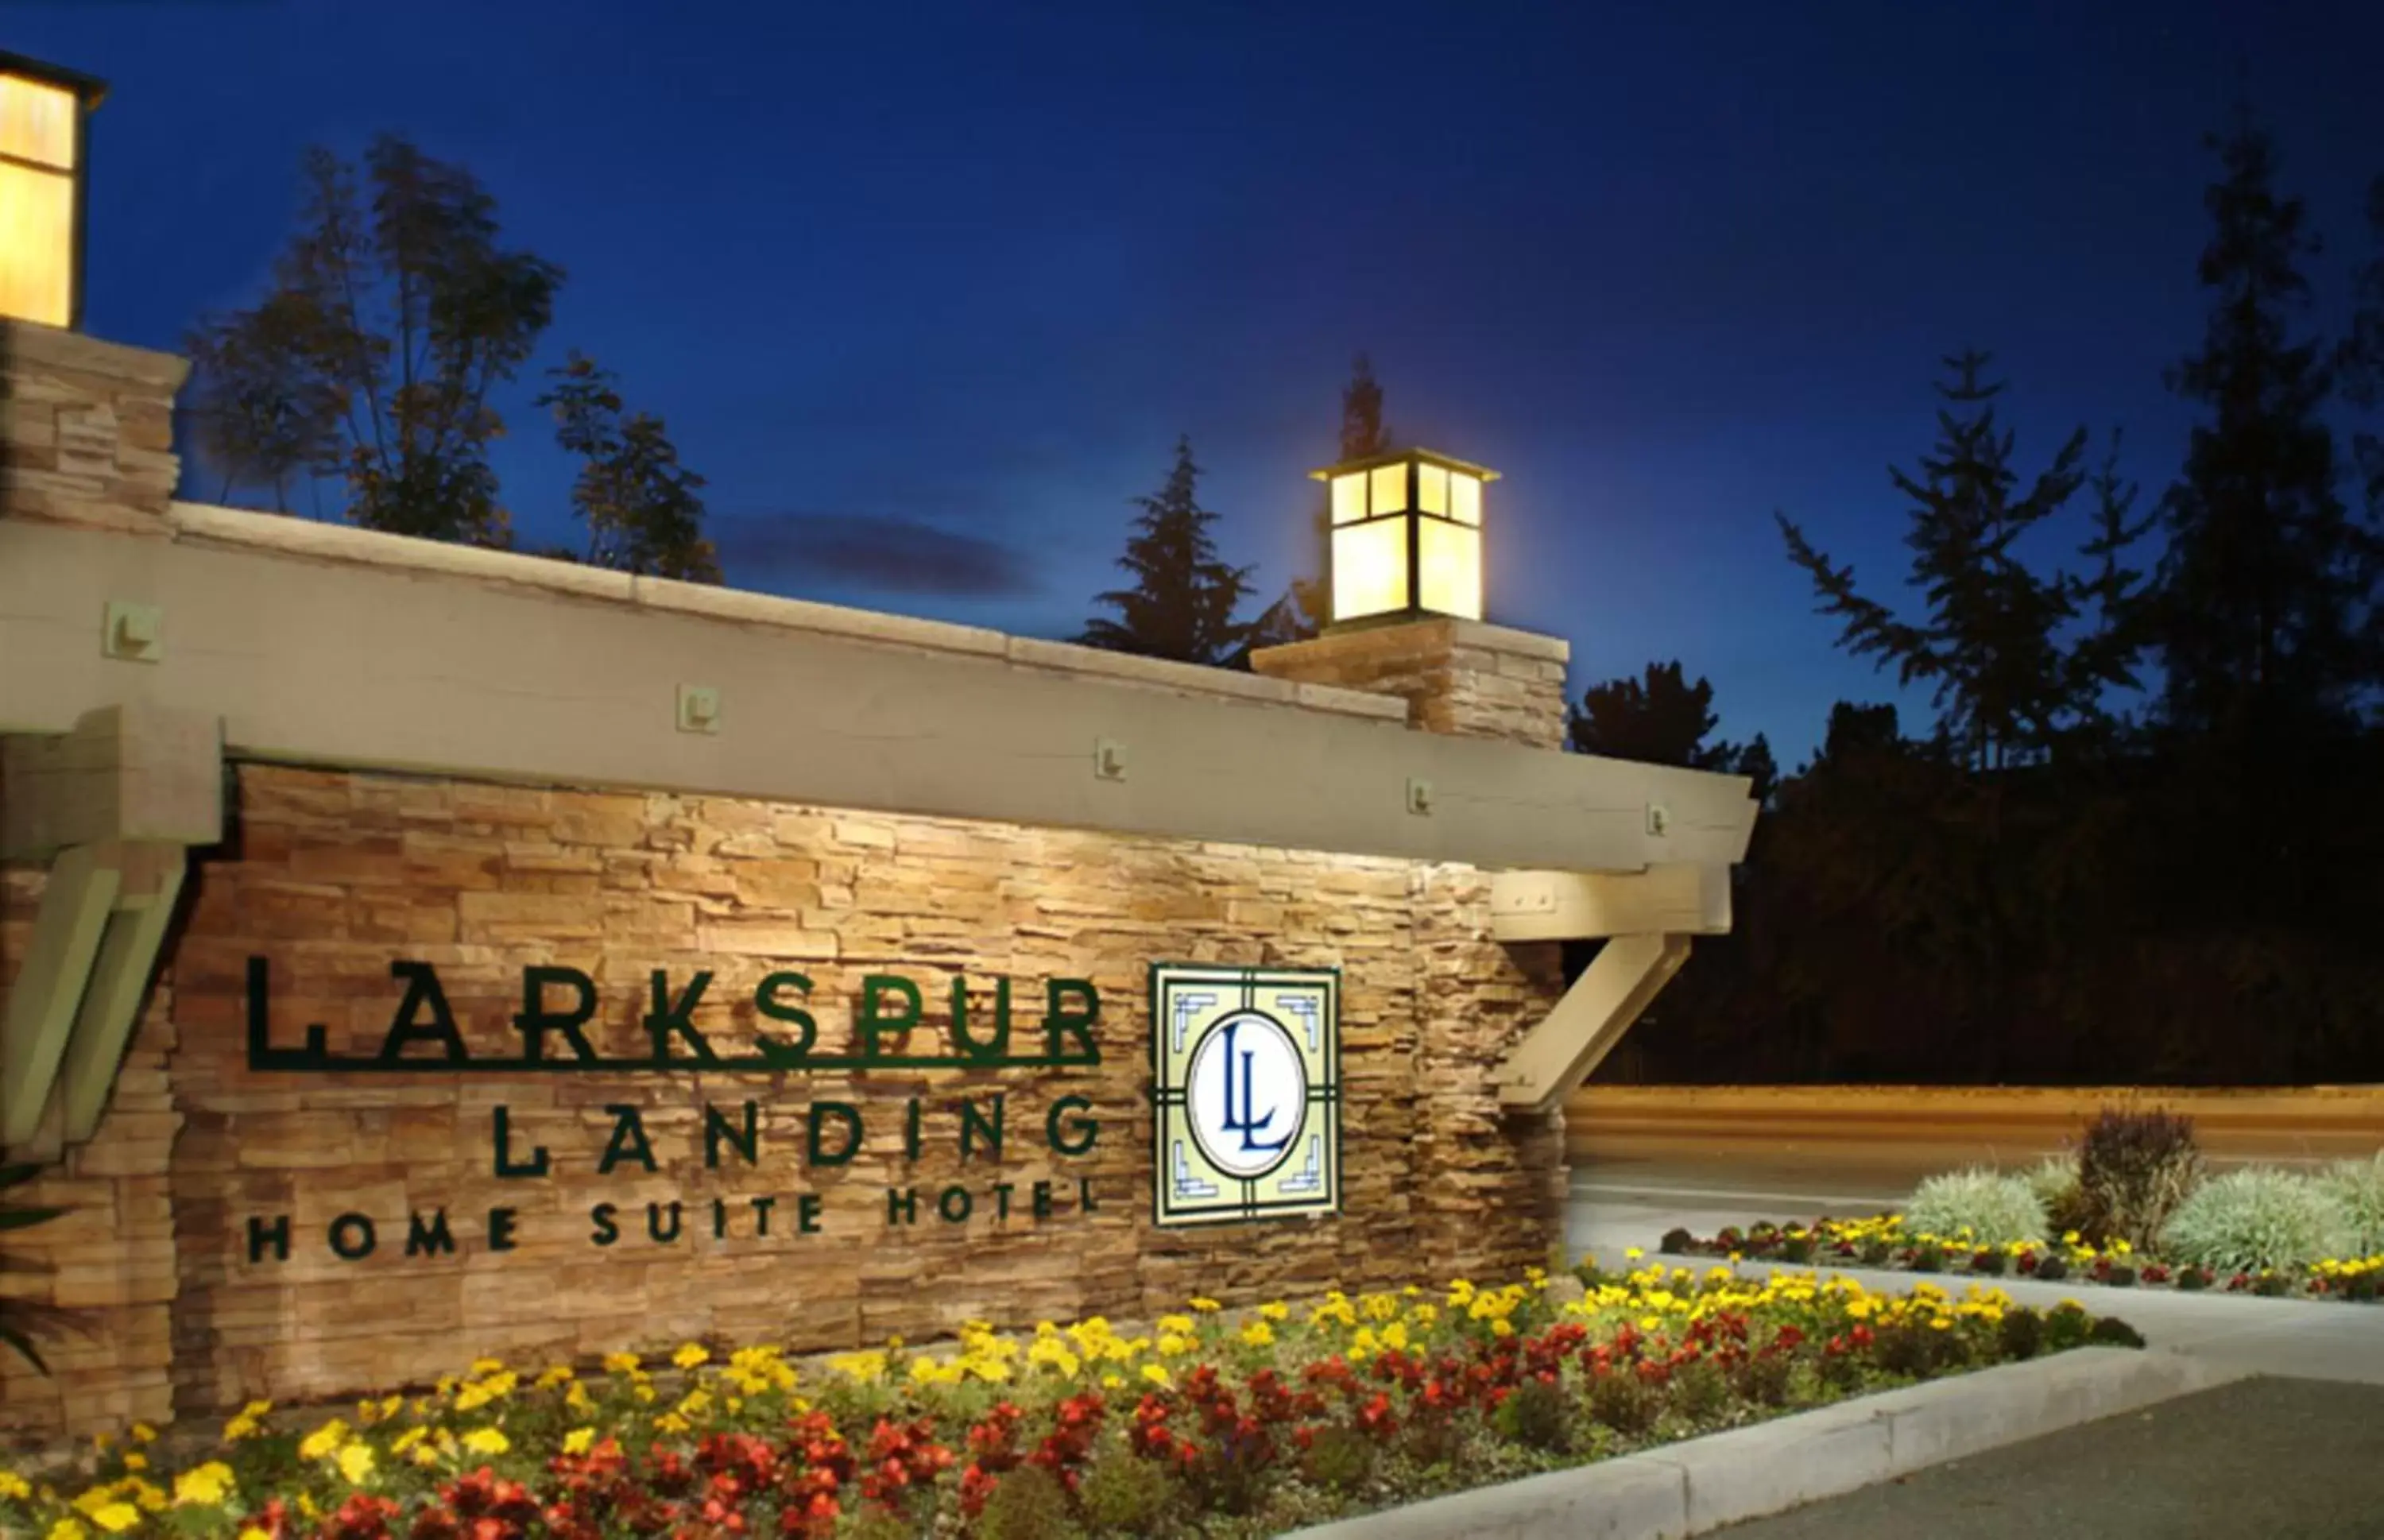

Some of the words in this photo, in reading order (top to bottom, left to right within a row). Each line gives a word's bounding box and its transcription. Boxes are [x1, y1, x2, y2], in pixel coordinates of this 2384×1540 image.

[246, 956, 1101, 1071] LARKSPUR
[493, 1095, 1100, 1178] LANDING
[246, 1206, 518, 1263] HOME
[590, 1194, 822, 1246] SUITE
[888, 1177, 1099, 1225] HOTEL
